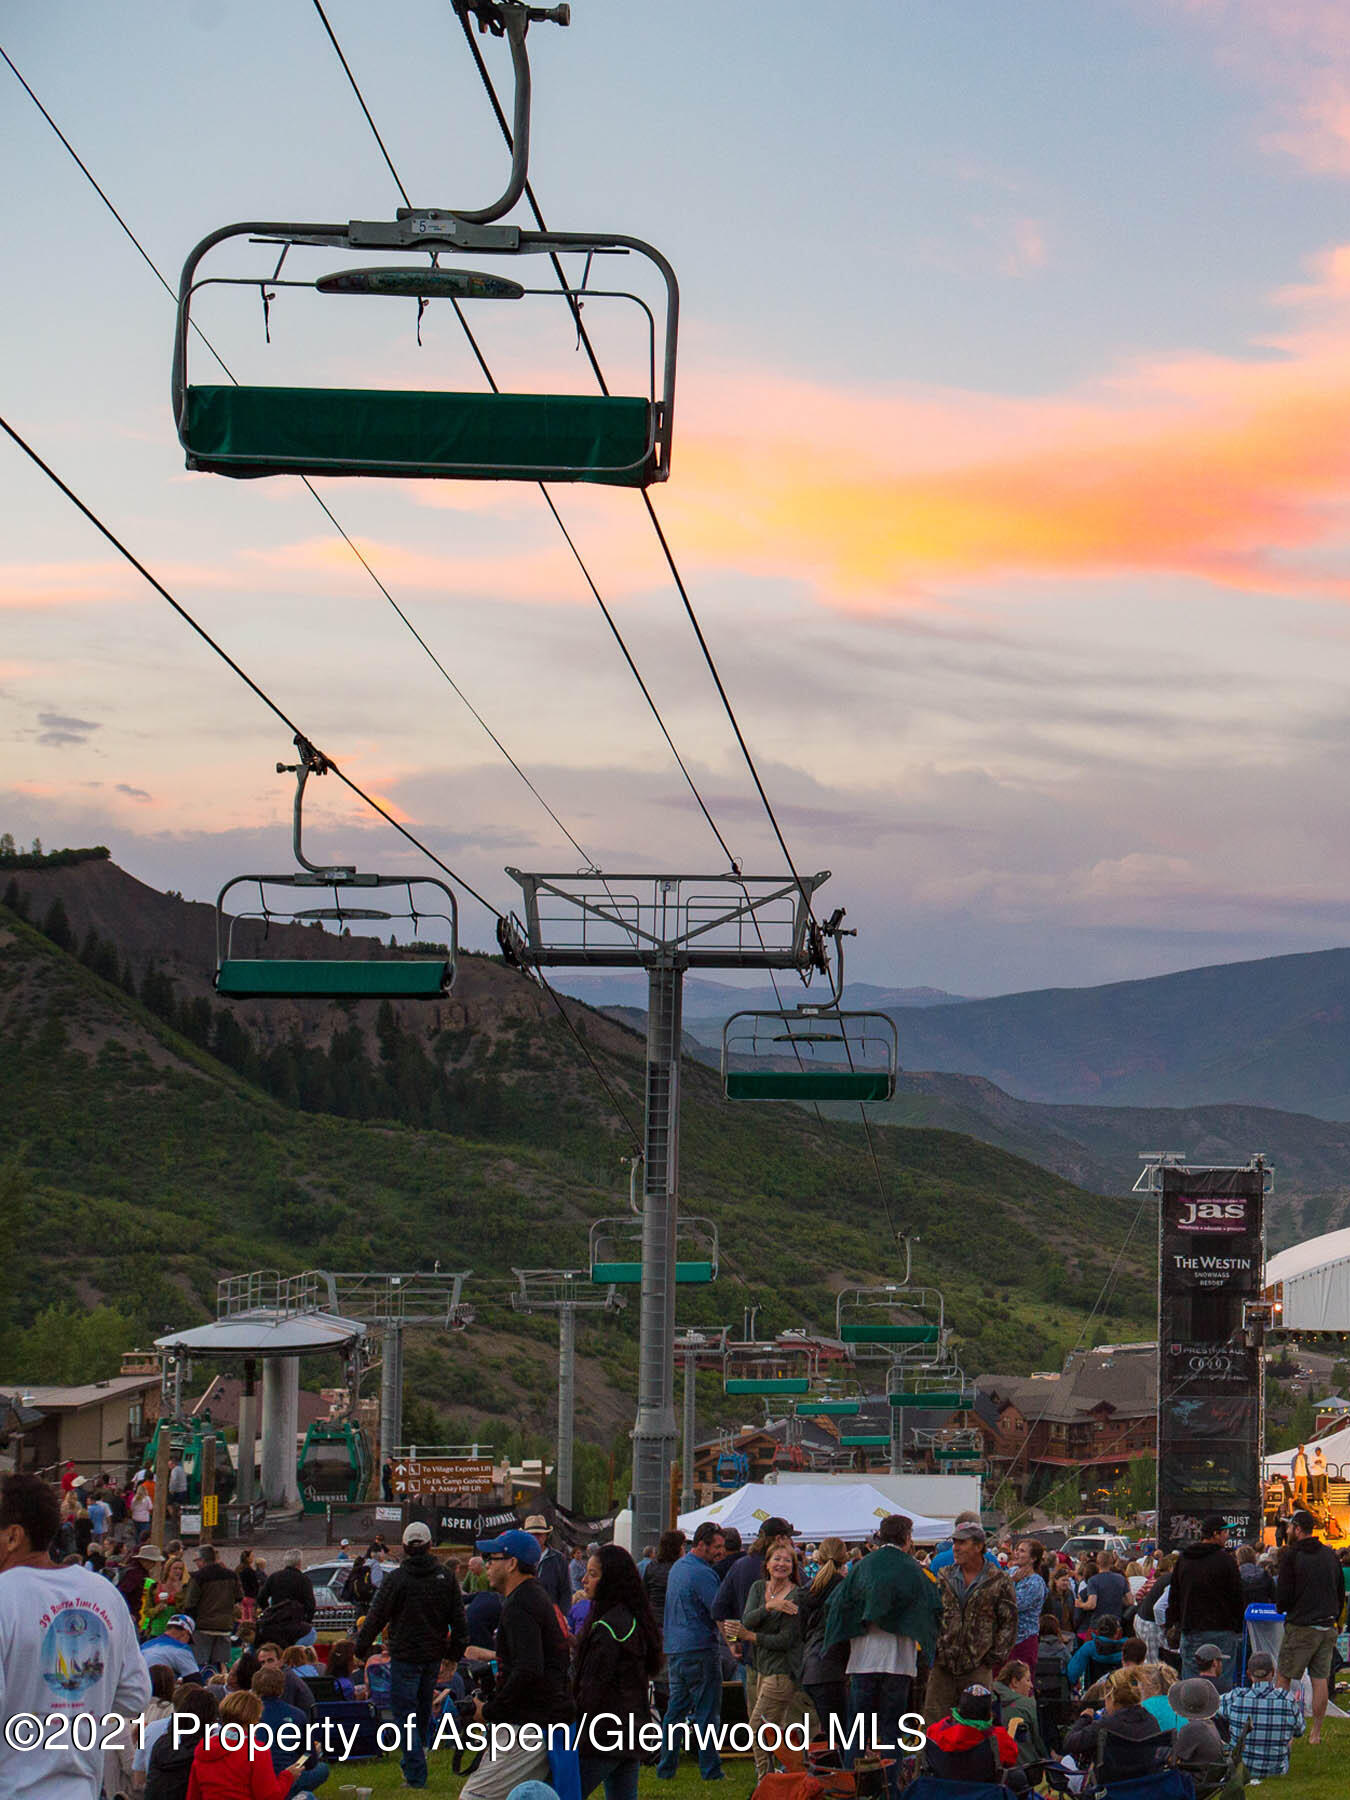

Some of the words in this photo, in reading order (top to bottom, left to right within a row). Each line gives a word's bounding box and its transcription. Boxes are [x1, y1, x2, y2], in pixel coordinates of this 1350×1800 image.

[419, 220, 427, 233] 5
[1178, 1203, 1246, 1225] jas
[1194, 1271, 1231, 1279] SNOWMASS
[422, 1465, 432, 1473] To
[432, 1465, 455, 1474] Village
[455, 1465, 480, 1474] Express
[480, 1465, 491, 1473] Lift
[422, 1477, 431, 1485] To
[442, 1477, 463, 1487] Camp
[463, 1477, 490, 1485] Gondola
[439, 1485, 458, 1494] Assay
[471, 1484, 482, 1492] Lift
[440, 1516, 472, 1531] ASPEN
